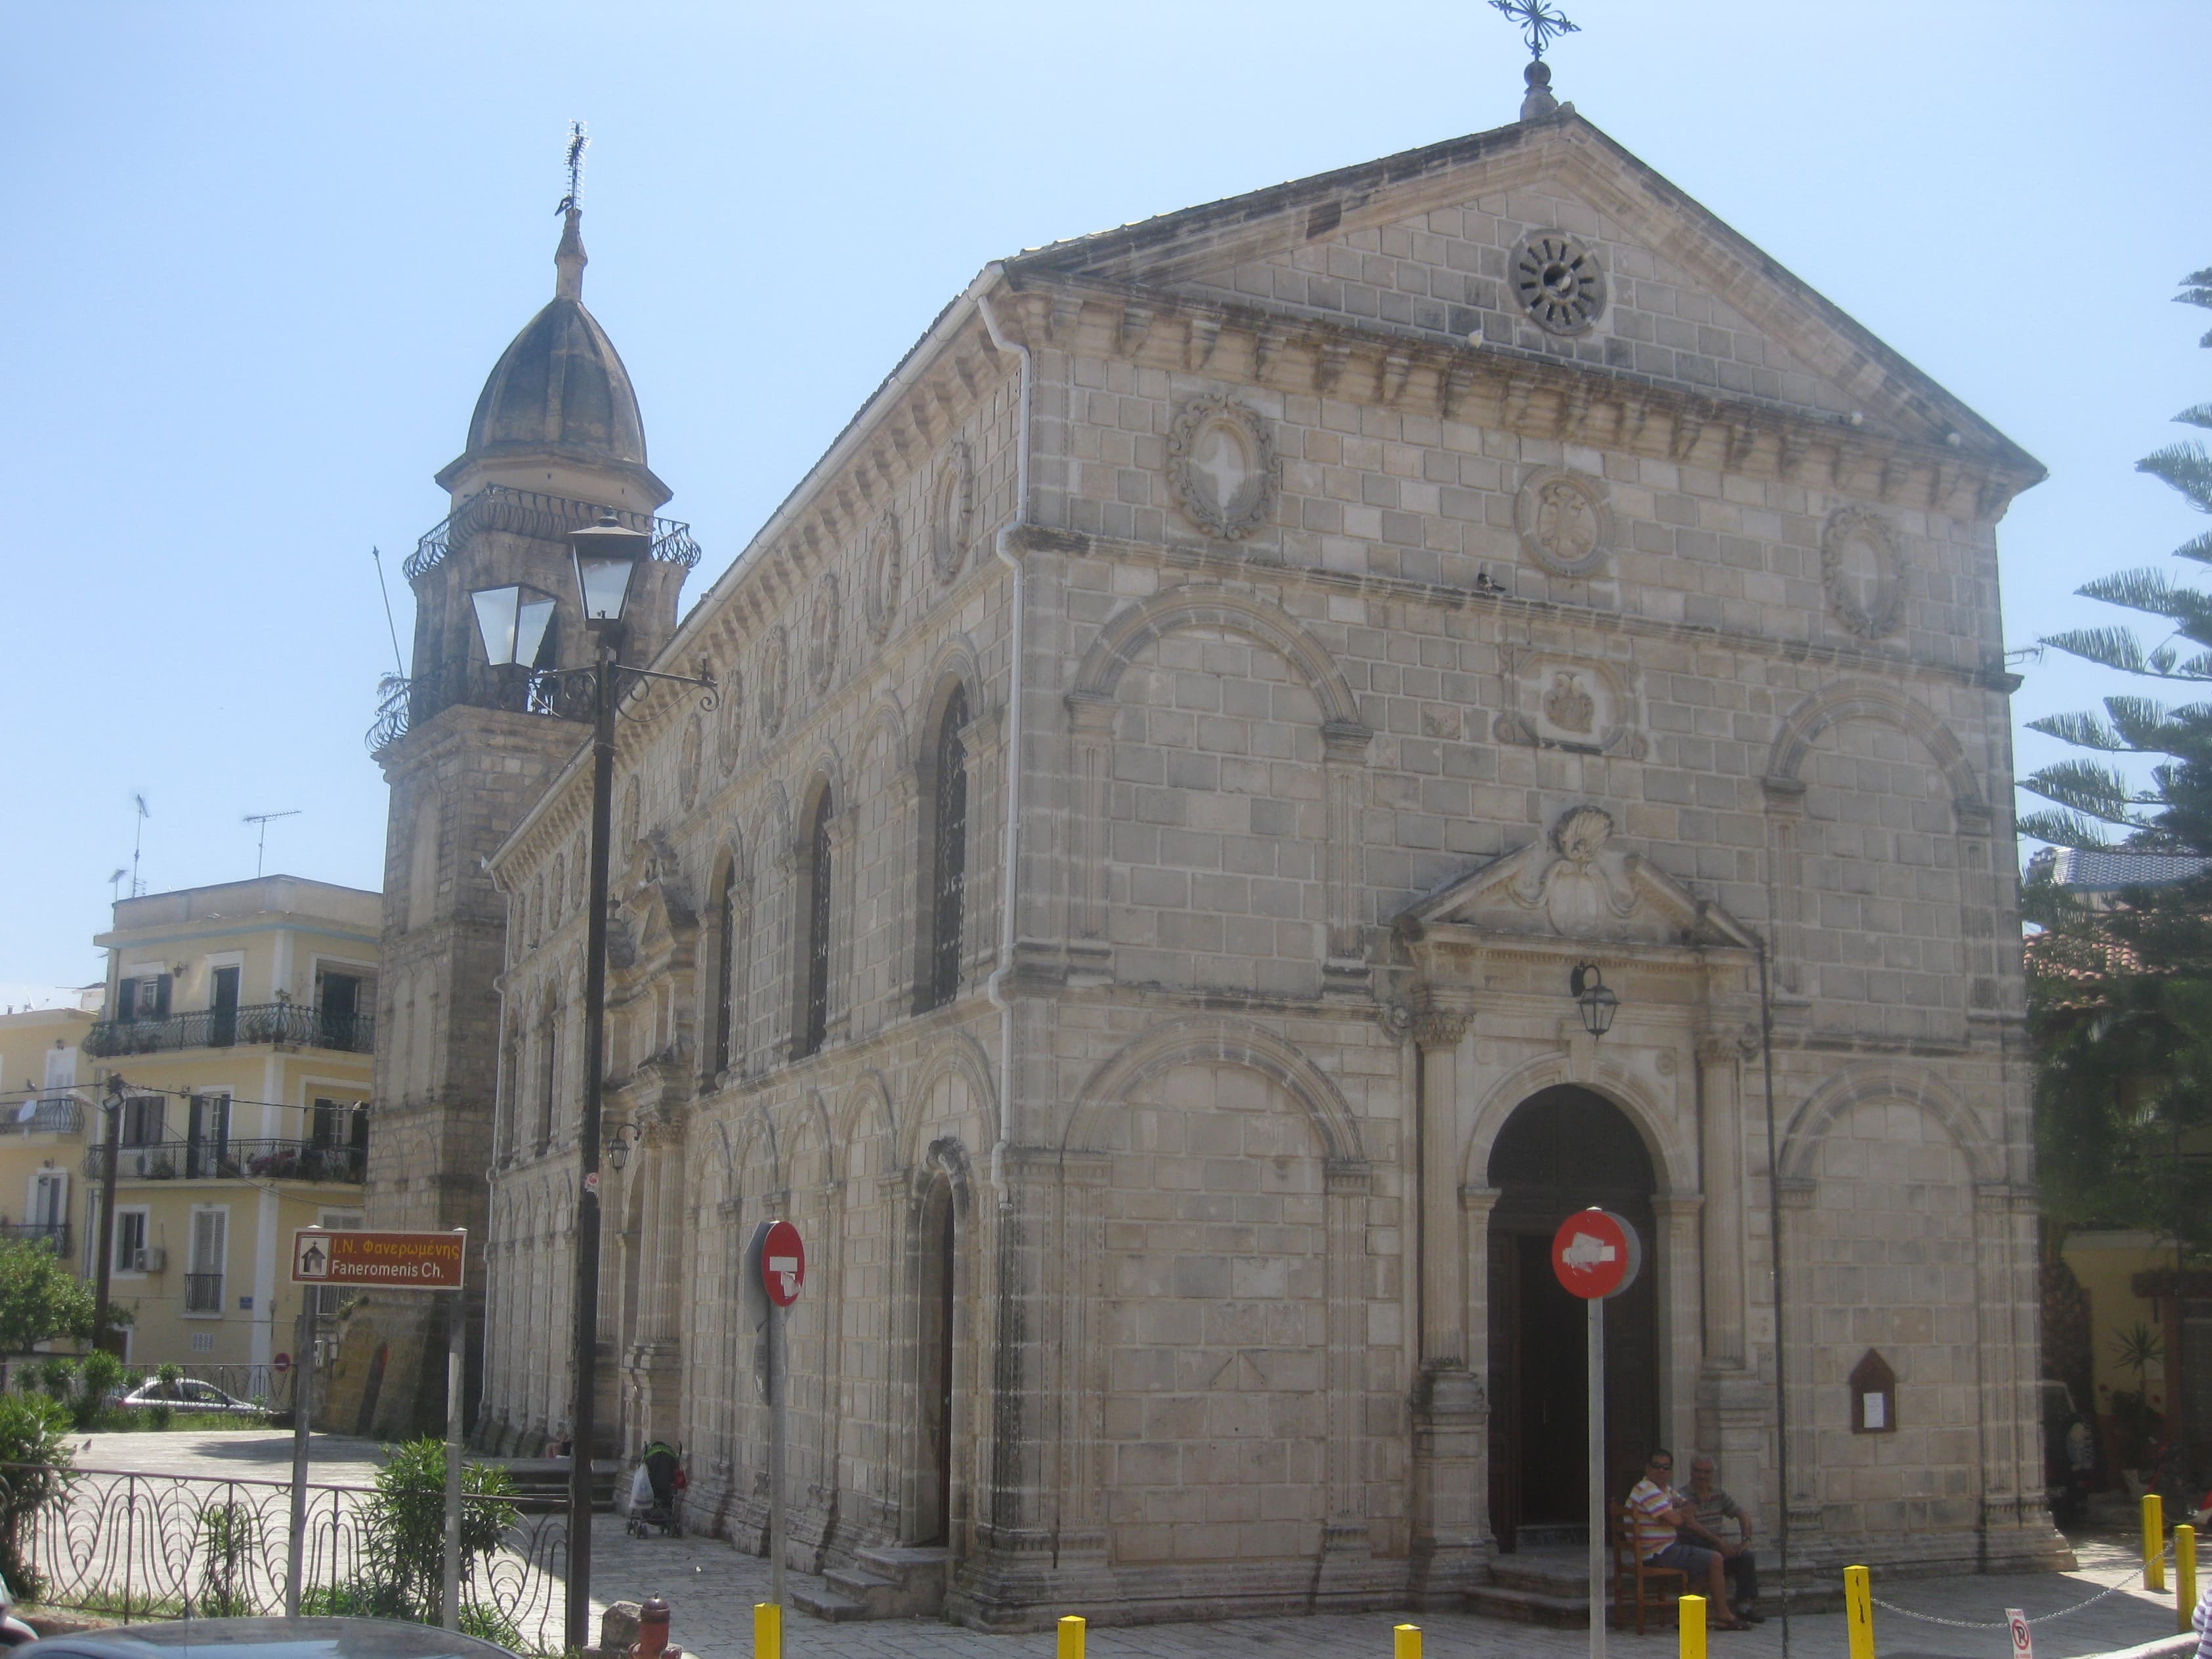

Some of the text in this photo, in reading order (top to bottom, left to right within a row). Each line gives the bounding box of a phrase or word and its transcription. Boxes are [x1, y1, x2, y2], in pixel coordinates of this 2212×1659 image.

[363, 1239, 459, 1259] Φανερωμένης
[332, 1260, 444, 1278] Faneromenis Ch.
